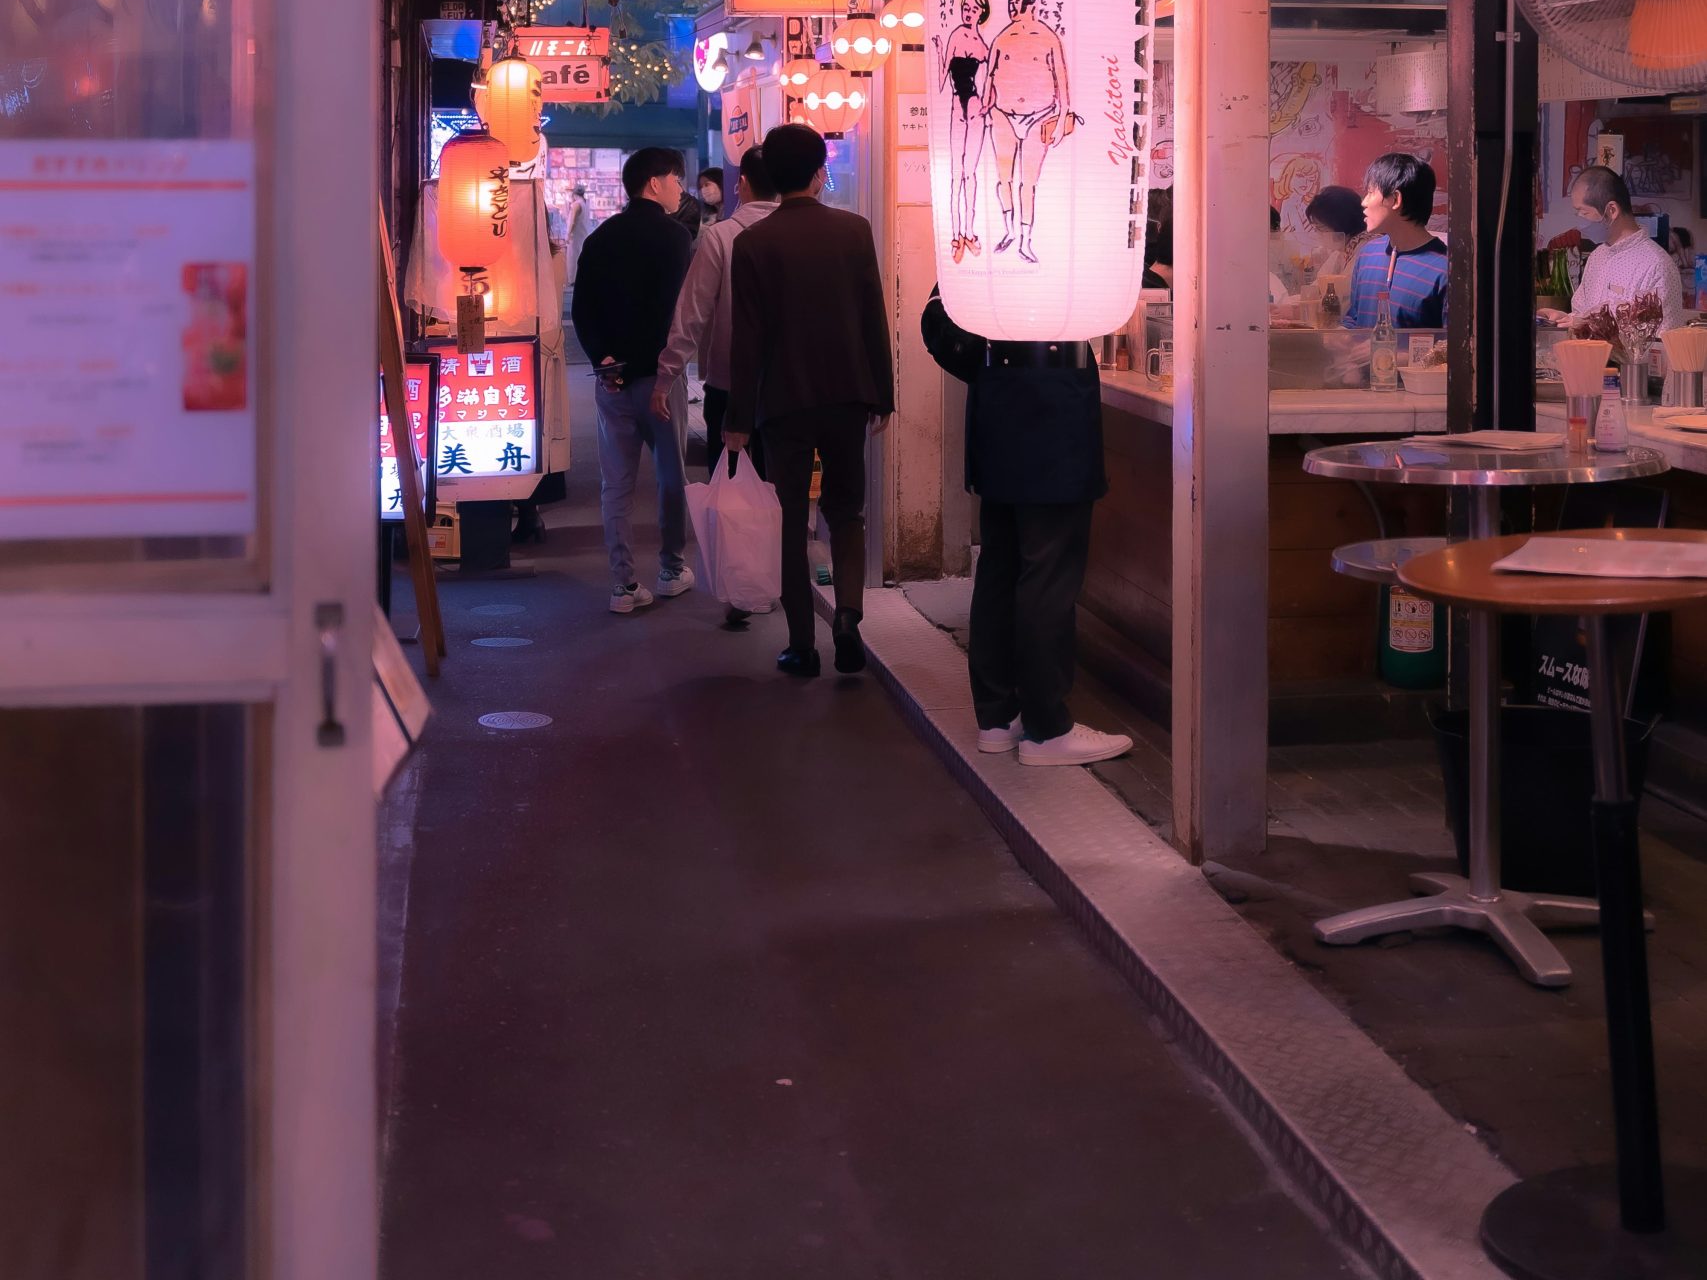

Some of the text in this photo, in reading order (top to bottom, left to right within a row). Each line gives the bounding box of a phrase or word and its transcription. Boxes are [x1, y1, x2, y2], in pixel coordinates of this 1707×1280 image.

[541, 63, 590, 84] afé
[1101, 53, 1134, 166] Yakitori
[438, 442, 531, 475] 美舟
